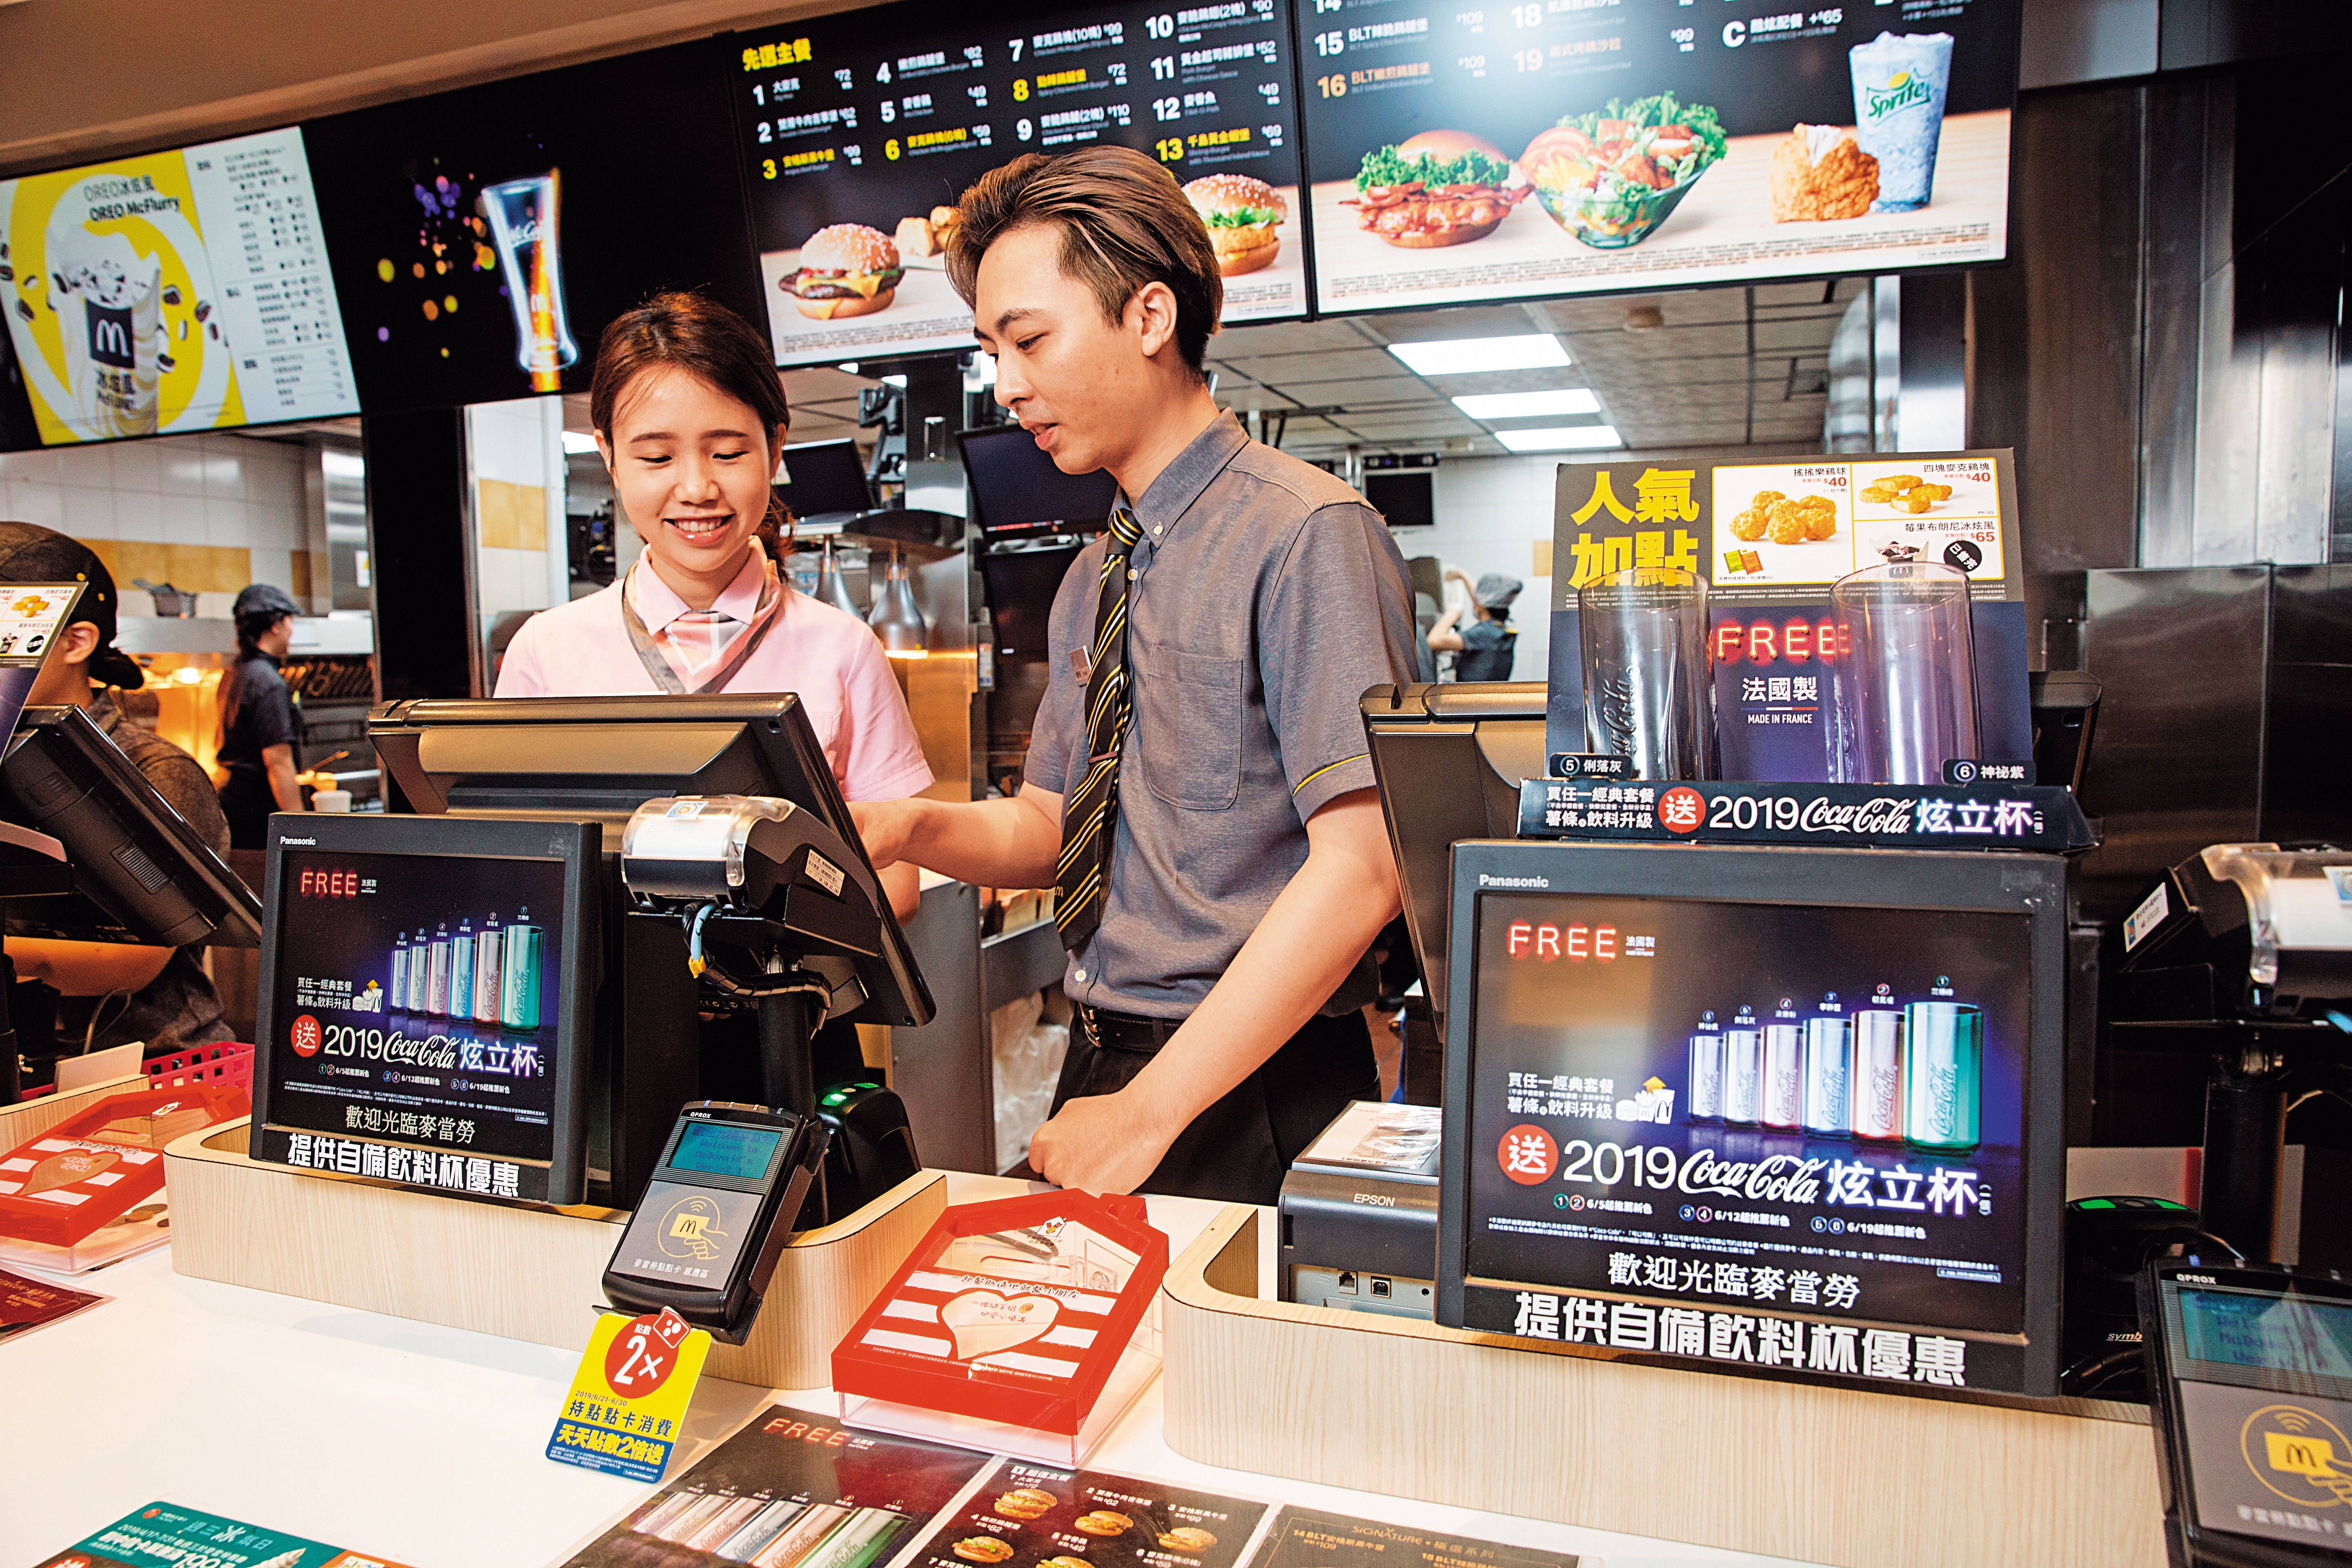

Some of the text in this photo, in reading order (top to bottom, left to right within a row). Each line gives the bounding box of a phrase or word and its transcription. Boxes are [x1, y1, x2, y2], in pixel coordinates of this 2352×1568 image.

[1145, 14, 1174, 40] 10
[1510, 2, 1543, 29] 18
[1314, 31, 1344, 57] 15
[1722, 20, 1746, 47] C
[1009, 38, 1023, 62] 7
[1513, 49, 1544, 73] 19
[876, 62, 891, 84] 4
[1151, 56, 1174, 80] 11
[753, 84, 764, 106] 1
[1013, 79, 1029, 101] 8
[1317, 73, 1347, 99] 16
[880, 100, 895, 122] 5
[1152, 96, 1181, 122] 12
[1869, 80, 1925, 118] Sprite
[757, 122, 772, 143] 2
[1016, 118, 1032, 141] 9
[885, 139, 900, 160] 6
[1156, 138, 1184, 162] 13
[762, 159, 777, 180] 3
[1823, 477, 1847, 486] $40
[1966, 472, 1991, 482] $40
[1570, 466, 1701, 526] 人氣
[1904, 521, 1995, 532] 莓果布朗尼冰炫風
[1971, 532, 1995, 542] $65
[1568, 529, 1699, 590] 加點
[1949, 543, 1978, 570] 已售完
[1716, 622, 1851, 660] FREE
[1742, 675, 1818, 703] 法國製
[1747, 713, 1813, 724] MADE IN FRANCE
[1547, 786, 1655, 804] 買任一經典套餐
[1665, 794, 1697, 824] 送
[1709, 796, 1798, 832] 2019
[1800, 796, 1918, 833] Coca-Cola
[1917, 798, 2034, 836] 炫立杯
[280, 836, 316, 845] Panasonic
[301, 872, 357, 895] FREE
[1479, 874, 1549, 888] Panasonic
[1510, 924, 1616, 959] FREE
[297, 977, 352, 991] 買任一經典套餐
[296, 1022, 316, 1049] 送
[324, 1025, 383, 1060] 2019
[383, 1030, 462, 1069] Coca-Cola
[459, 1037, 538, 1078] 炫立杯
[345, 1105, 476, 1145] 歡迎光臨麥當勞
[288, 1132, 520, 1198] 提供自備飲料杯優惠
[1508, 1134, 1547, 1174] 送
[1564, 1139, 1677, 1189] 2019
[1677, 1148, 1827, 1205] Coca-Cola
[1824, 1158, 1979, 1218] 炫立杯
[1353, 1193, 1395, 1207] EPSON
[633, 1258, 682, 1274] 麥當勞點點卡
[1608, 1251, 1861, 1310] 歡迎光臨麥當勞
[2176, 1273, 2217, 1285] QPROX
[634, 1323, 652, 1336] 點數
[1514, 1290, 1967, 1387] 提供自備飲料杯優惠
[575, 1390, 627, 1407] 2019/6/21-6/30
[568, 1399, 673, 1437] 持點點卡消費
[556, 1423, 665, 1465] 天天點數2倍送
[764, 1417, 851, 1447] FREE
[1352, 1525, 1423, 1545] SIGNATURE
